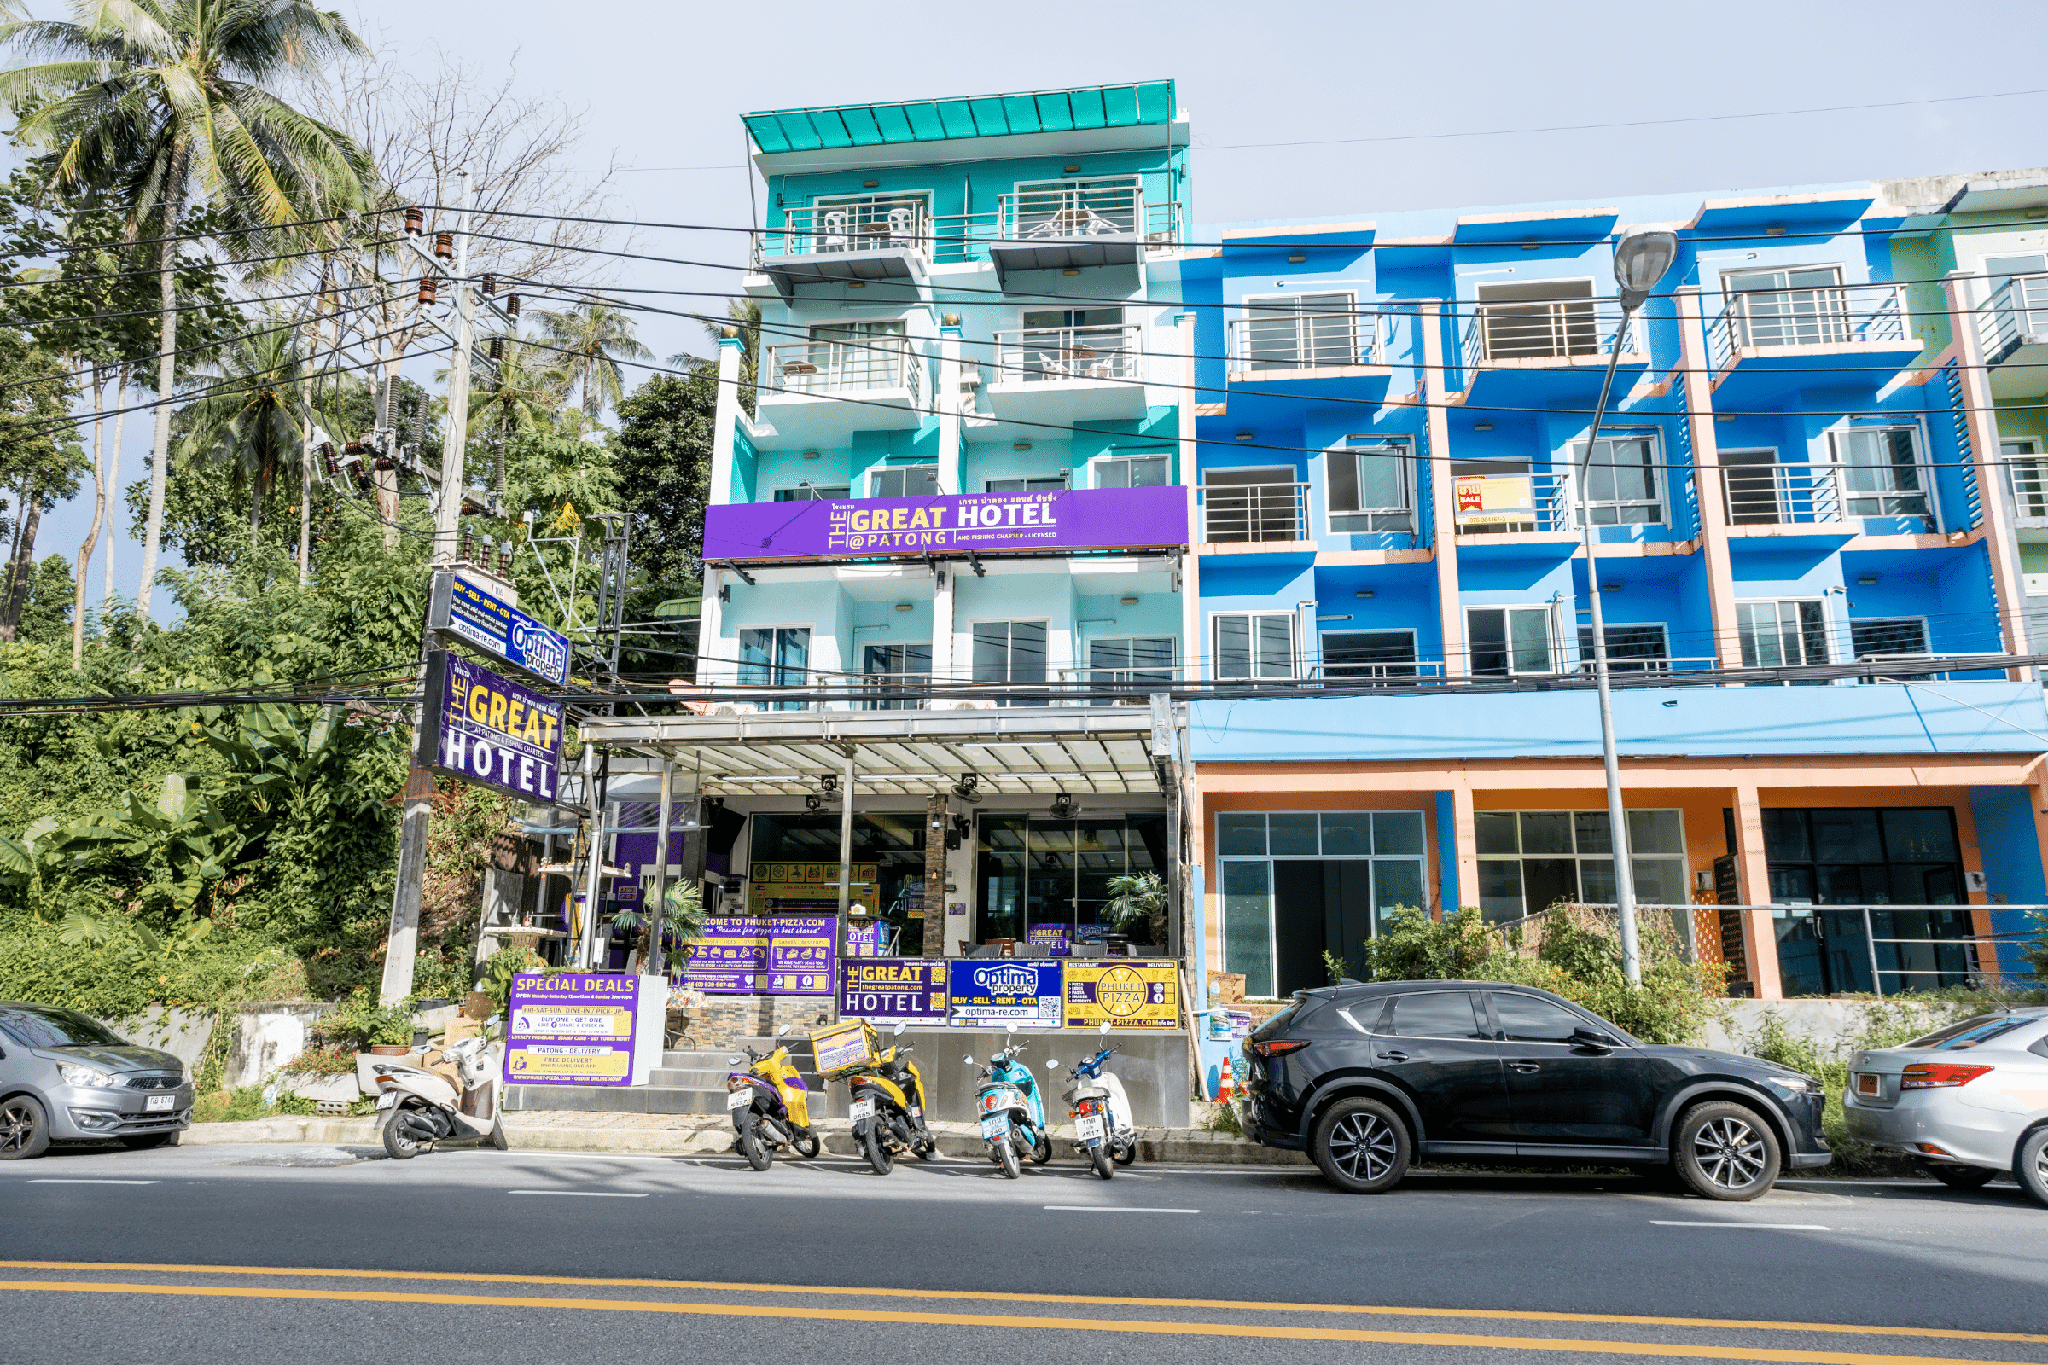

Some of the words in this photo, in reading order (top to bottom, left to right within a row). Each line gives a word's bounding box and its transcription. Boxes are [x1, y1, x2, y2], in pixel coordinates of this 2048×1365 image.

[851, 507, 947, 531] GREAT
[958, 502, 1056, 526] HOTEL
[828, 510, 847, 549] THE
[849, 532, 946, 550] @PATONG
[454, 582, 466, 595] BUY
[468, 590, 481, 603] SELL
[483, 598, 497, 612] RENT
[514, 624, 563, 668] Optima
[526, 654, 562, 680] property
[448, 674, 466, 724] THE
[469, 684, 558, 749] GREAT
[481, 730, 500, 741] PATONG
[505, 738, 523, 751] FISHING
[524, 745, 544, 758] CHARTER
[446, 729, 552, 799] HOTEL
[731, 918, 742, 926] TO
[745, 918, 825, 926] PHUKET-PIZZA.COM
[516, 978, 580, 991] SPECIAL
[584, 979, 634, 992] DEALS
[847, 966, 859, 990] THE
[862, 966, 923, 981] GREAT
[975, 969, 1036, 986] Optima
[992, 984, 1036, 993] property
[1101, 982, 1143, 991] PHUKET
[847, 994, 922, 1011] HOTEL
[1103, 993, 1140, 1002] PIZZA
[965, 1008, 1028, 1016] optima-re.com
